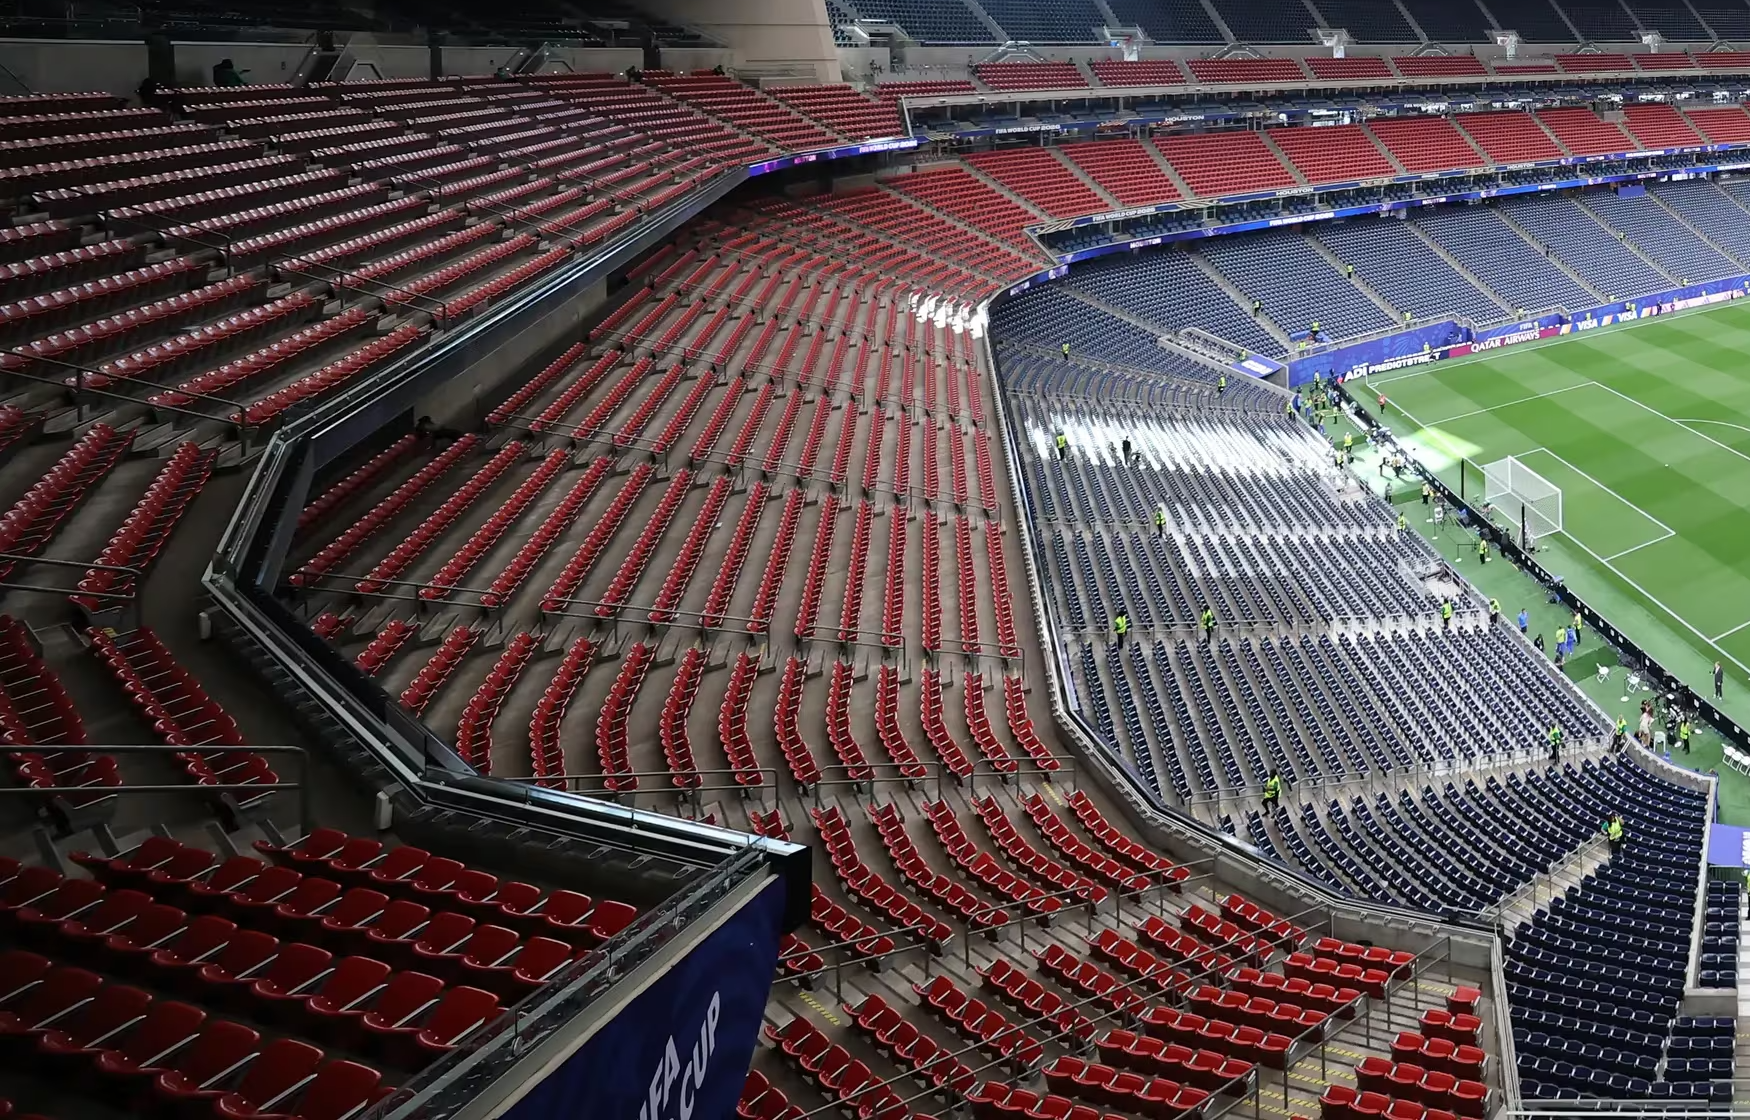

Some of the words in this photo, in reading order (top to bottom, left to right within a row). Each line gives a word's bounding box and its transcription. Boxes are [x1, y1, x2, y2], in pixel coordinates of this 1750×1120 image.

[870, 143, 889, 152] WORLD
[1275, 187, 1314, 196] HOUSTON
[1092, 214, 1105, 222] FIFA
[1106, 212, 1126, 220] WORLD
[1616, 310, 1638, 323] VISA
[1519, 322, 1533, 331] FIFA
[1575, 318, 1599, 331] VISA
[1470, 338, 1502, 353] QATAR
[1504, 330, 1540, 346] AIRWAYS
[1344, 366, 1368, 383] ADI
[679, 990, 721, 1120] CUP
